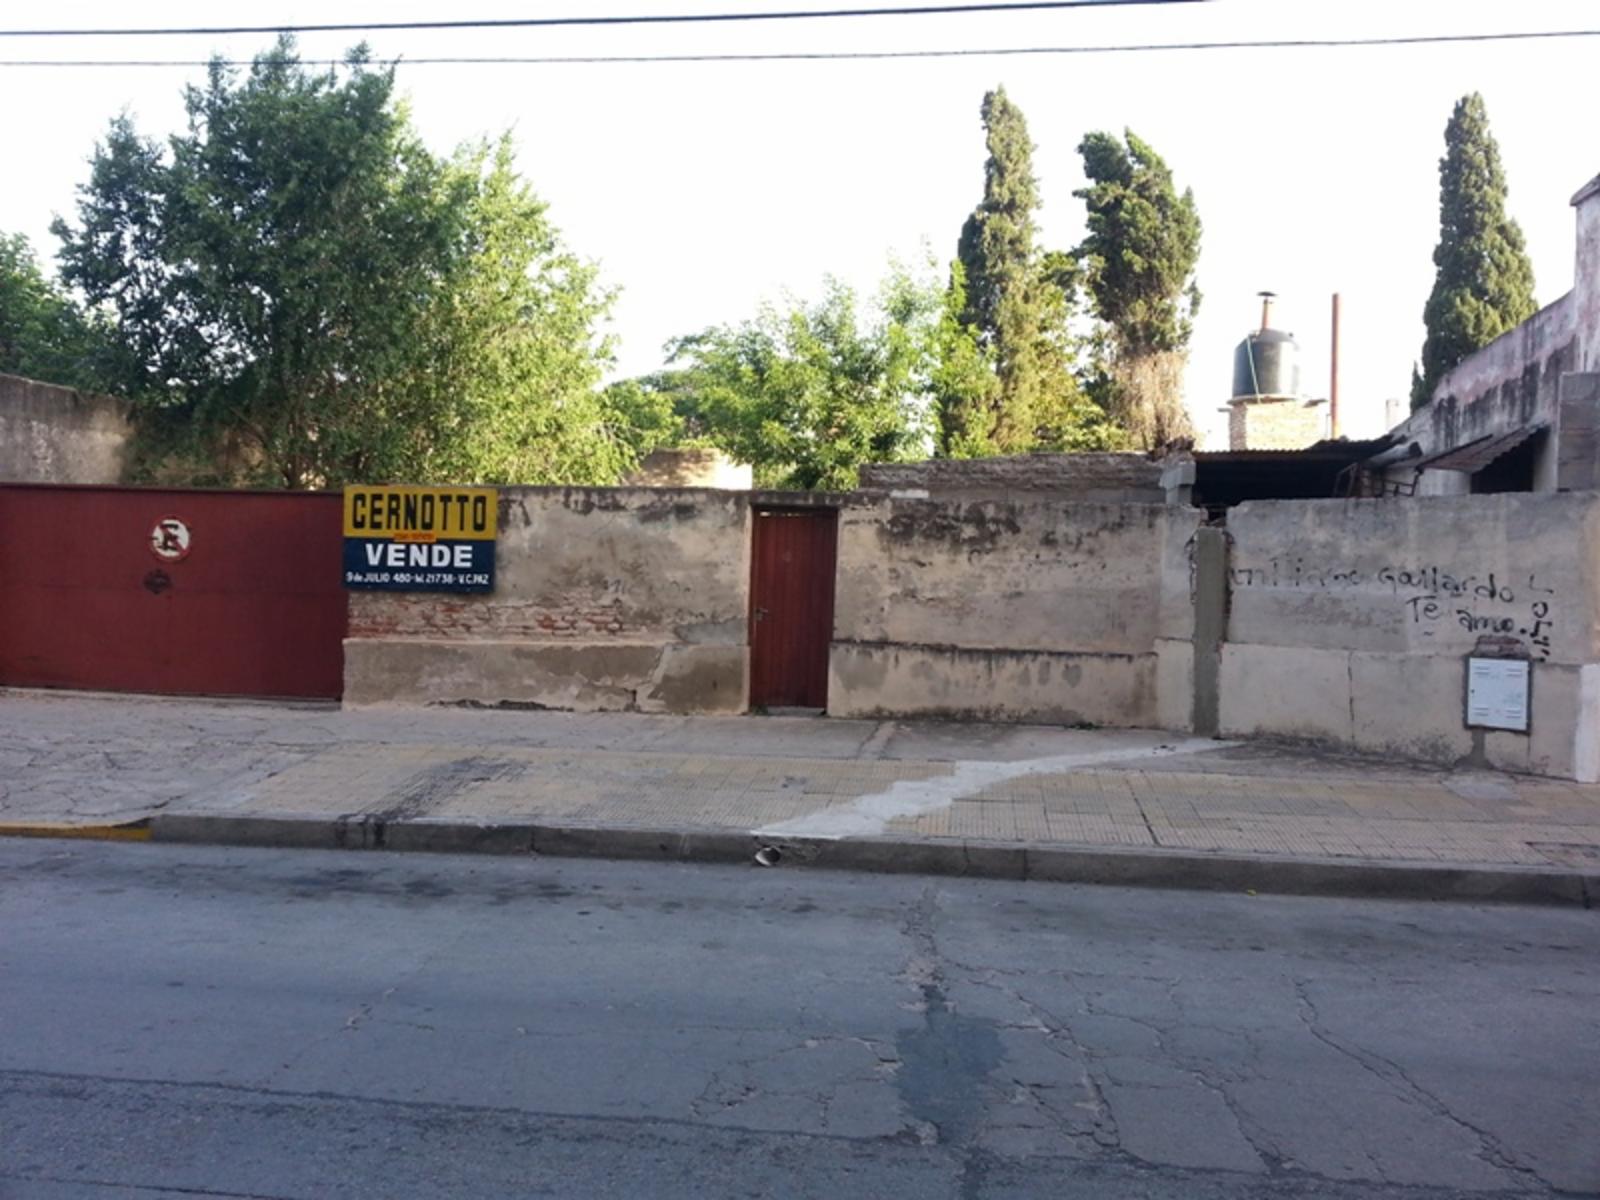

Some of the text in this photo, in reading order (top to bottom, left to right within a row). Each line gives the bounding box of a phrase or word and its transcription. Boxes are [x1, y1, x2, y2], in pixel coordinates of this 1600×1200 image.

[352, 492, 487, 532] CERNOTTO
[365, 543, 473, 568] VENDE
[363, 572, 391, 584] JULIO
